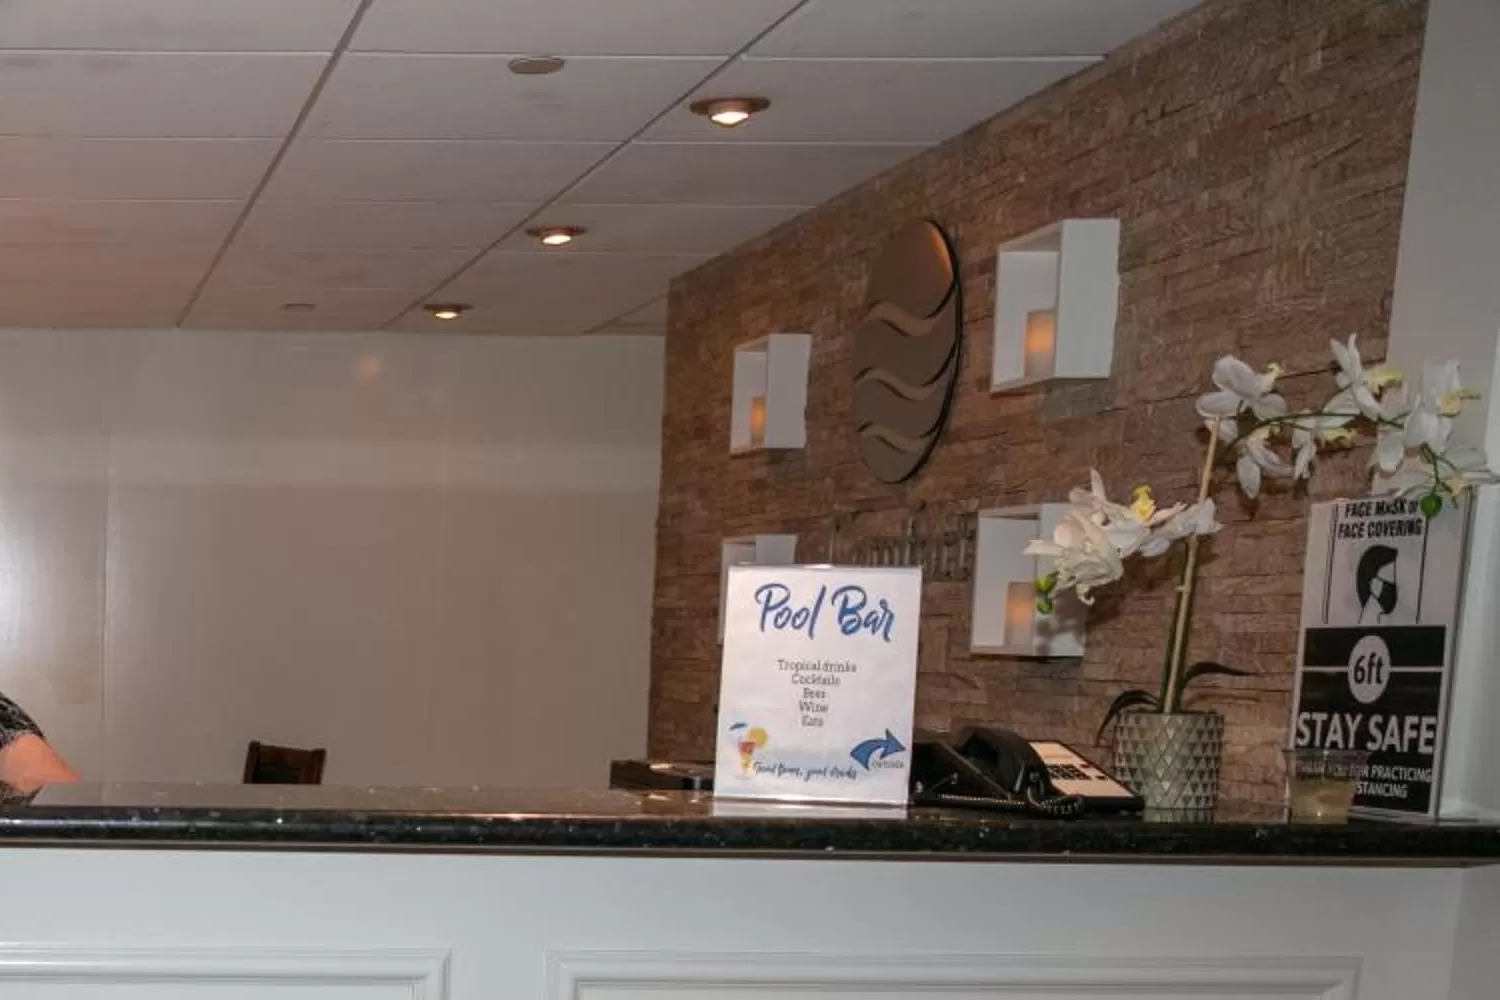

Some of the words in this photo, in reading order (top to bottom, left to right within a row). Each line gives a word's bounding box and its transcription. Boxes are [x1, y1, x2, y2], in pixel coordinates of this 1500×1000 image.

[1344, 501, 1372, 517] FACE
[1375, 498, 1406, 515] MASK
[1337, 521, 1367, 539] FACE
[1367, 518, 1422, 538] COVERING
[754, 583, 827, 641] Pool
[831, 585, 895, 644] Bar
[777, 659, 820, 673] Tropical
[822, 660, 858, 673] drinks
[1352, 652, 1384, 686] 6ft
[791, 673, 842, 685] Cocktails
[803, 687, 826, 699] Beer
[798, 700, 829, 713] Wine
[1295, 711, 1364, 751] STAY
[1365, 713, 1437, 756] SAFE
[1371, 764, 1433, 782] PRACTICING
